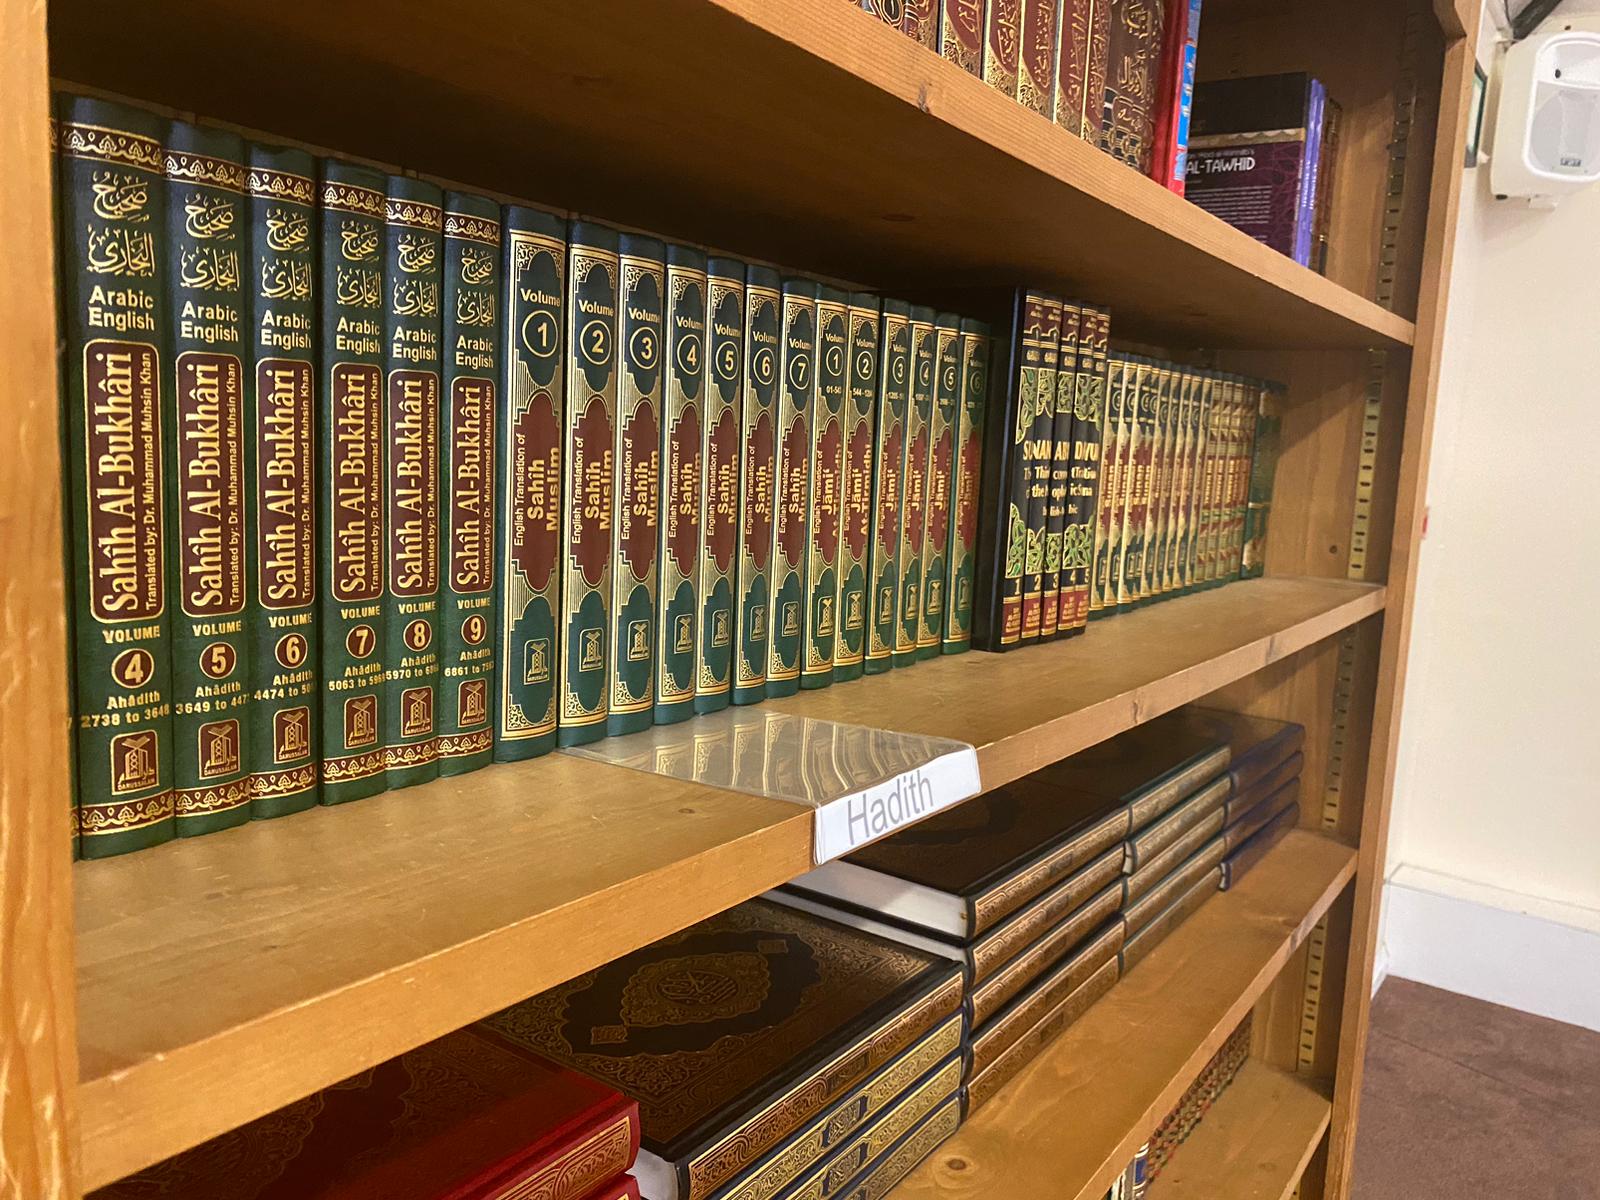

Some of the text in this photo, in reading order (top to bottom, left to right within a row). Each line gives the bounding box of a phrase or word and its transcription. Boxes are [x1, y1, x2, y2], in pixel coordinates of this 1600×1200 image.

[1186, 156, 1256, 174] AL-TAWHID
[89, 285, 154, 309] Arabic
[88, 306, 155, 331] English
[181, 300, 237, 322] Arabic
[262, 309, 311, 331] Arabic
[181, 321, 238, 343] English
[337, 317, 380, 336] Arabic
[393, 326, 436, 344] Arabic
[537, 322, 547, 348] 1
[261, 329, 311, 350] English
[336, 335, 381, 355] English
[456, 335, 493, 352] Arabic
[591, 330, 604, 354] 2
[641, 337, 652, 360] 3
[392, 343, 437, 361] English
[455, 352, 494, 370] English
[686, 344, 697, 366] 4
[724, 350, 734, 372] 5
[833, 354, 838, 370] 1
[140, 352, 151, 385] Khan
[225, 363, 236, 392] Khan
[761, 356, 771, 377] 6
[798, 362, 806, 381] 7
[862, 358, 869, 374] 2
[300, 369, 309, 397] Khan
[140, 387, 152, 432] Muhsin
[226, 395, 236, 438] Muhsin
[301, 400, 309, 439] Muhsin
[141, 434, 154, 503] Muhammad
[227, 440, 238, 507] Muhammad
[301, 443, 310, 504] Muhammad
[514, 433, 526, 546] English Translation of
[527, 459, 545, 520] Sahîh
[546, 447, 560, 531] Muslim
[572, 437, 584, 544] English Translation of
[584, 461, 601, 519] Sahîh
[599, 450, 612, 530] Muslim
[621, 438, 633, 540] English Translation of
[633, 461, 648, 516] Sahîh
[647, 450, 658, 527] Muslim
[669, 441, 680, 538] English Translation of
[680, 462, 693, 515] Sahîh
[717, 464, 730, 514] Sahîh
[755, 465, 767, 514] Sahîh
[789, 467, 801, 513] Sahîh
[143, 506, 155, 524] Dr.
[229, 508, 239, 524] Dr.
[302, 506, 310, 522] Dr.
[266, 523, 296, 600] Sahîh
[339, 519, 366, 592] Sahîh
[396, 519, 422, 588] Sahîh
[456, 519, 480, 585] Sahîh
[98, 524, 139, 611] Sahîh
[188, 525, 223, 607] Sahîh
[229, 549, 240, 605] Translated
[302, 543, 311, 598] Translated
[145, 550, 158, 610] Translated
[1035, 574, 1041, 590] 2
[1053, 573, 1058, 588] 3
[341, 606, 381, 620] VOLUME
[398, 602, 436, 614] VOLUME
[457, 598, 490, 610] VOLUME
[192, 621, 241, 637] VOLUME
[269, 612, 312, 629] VOLUME
[470, 617, 481, 641] 9
[102, 625, 161, 644] VOLUME
[355, 629, 369, 654] 7
[413, 623, 425, 647] 8
[211, 647, 227, 674] 5
[285, 637, 300, 664] 6
[124, 654, 144, 684] 4
[386, 669, 411, 681] 5970
[414, 668, 424, 677] to
[444, 666, 469, 676] 6861
[472, 665, 480, 674] to
[254, 688, 285, 700] 4474
[288, 686, 298, 697] to
[329, 679, 354, 691] 5063
[357, 678, 367, 687] to
[125, 712, 139, 723] to
[175, 701, 210, 714] 3649
[215, 701, 227, 711] to
[848, 770, 934, 846] Hadith
